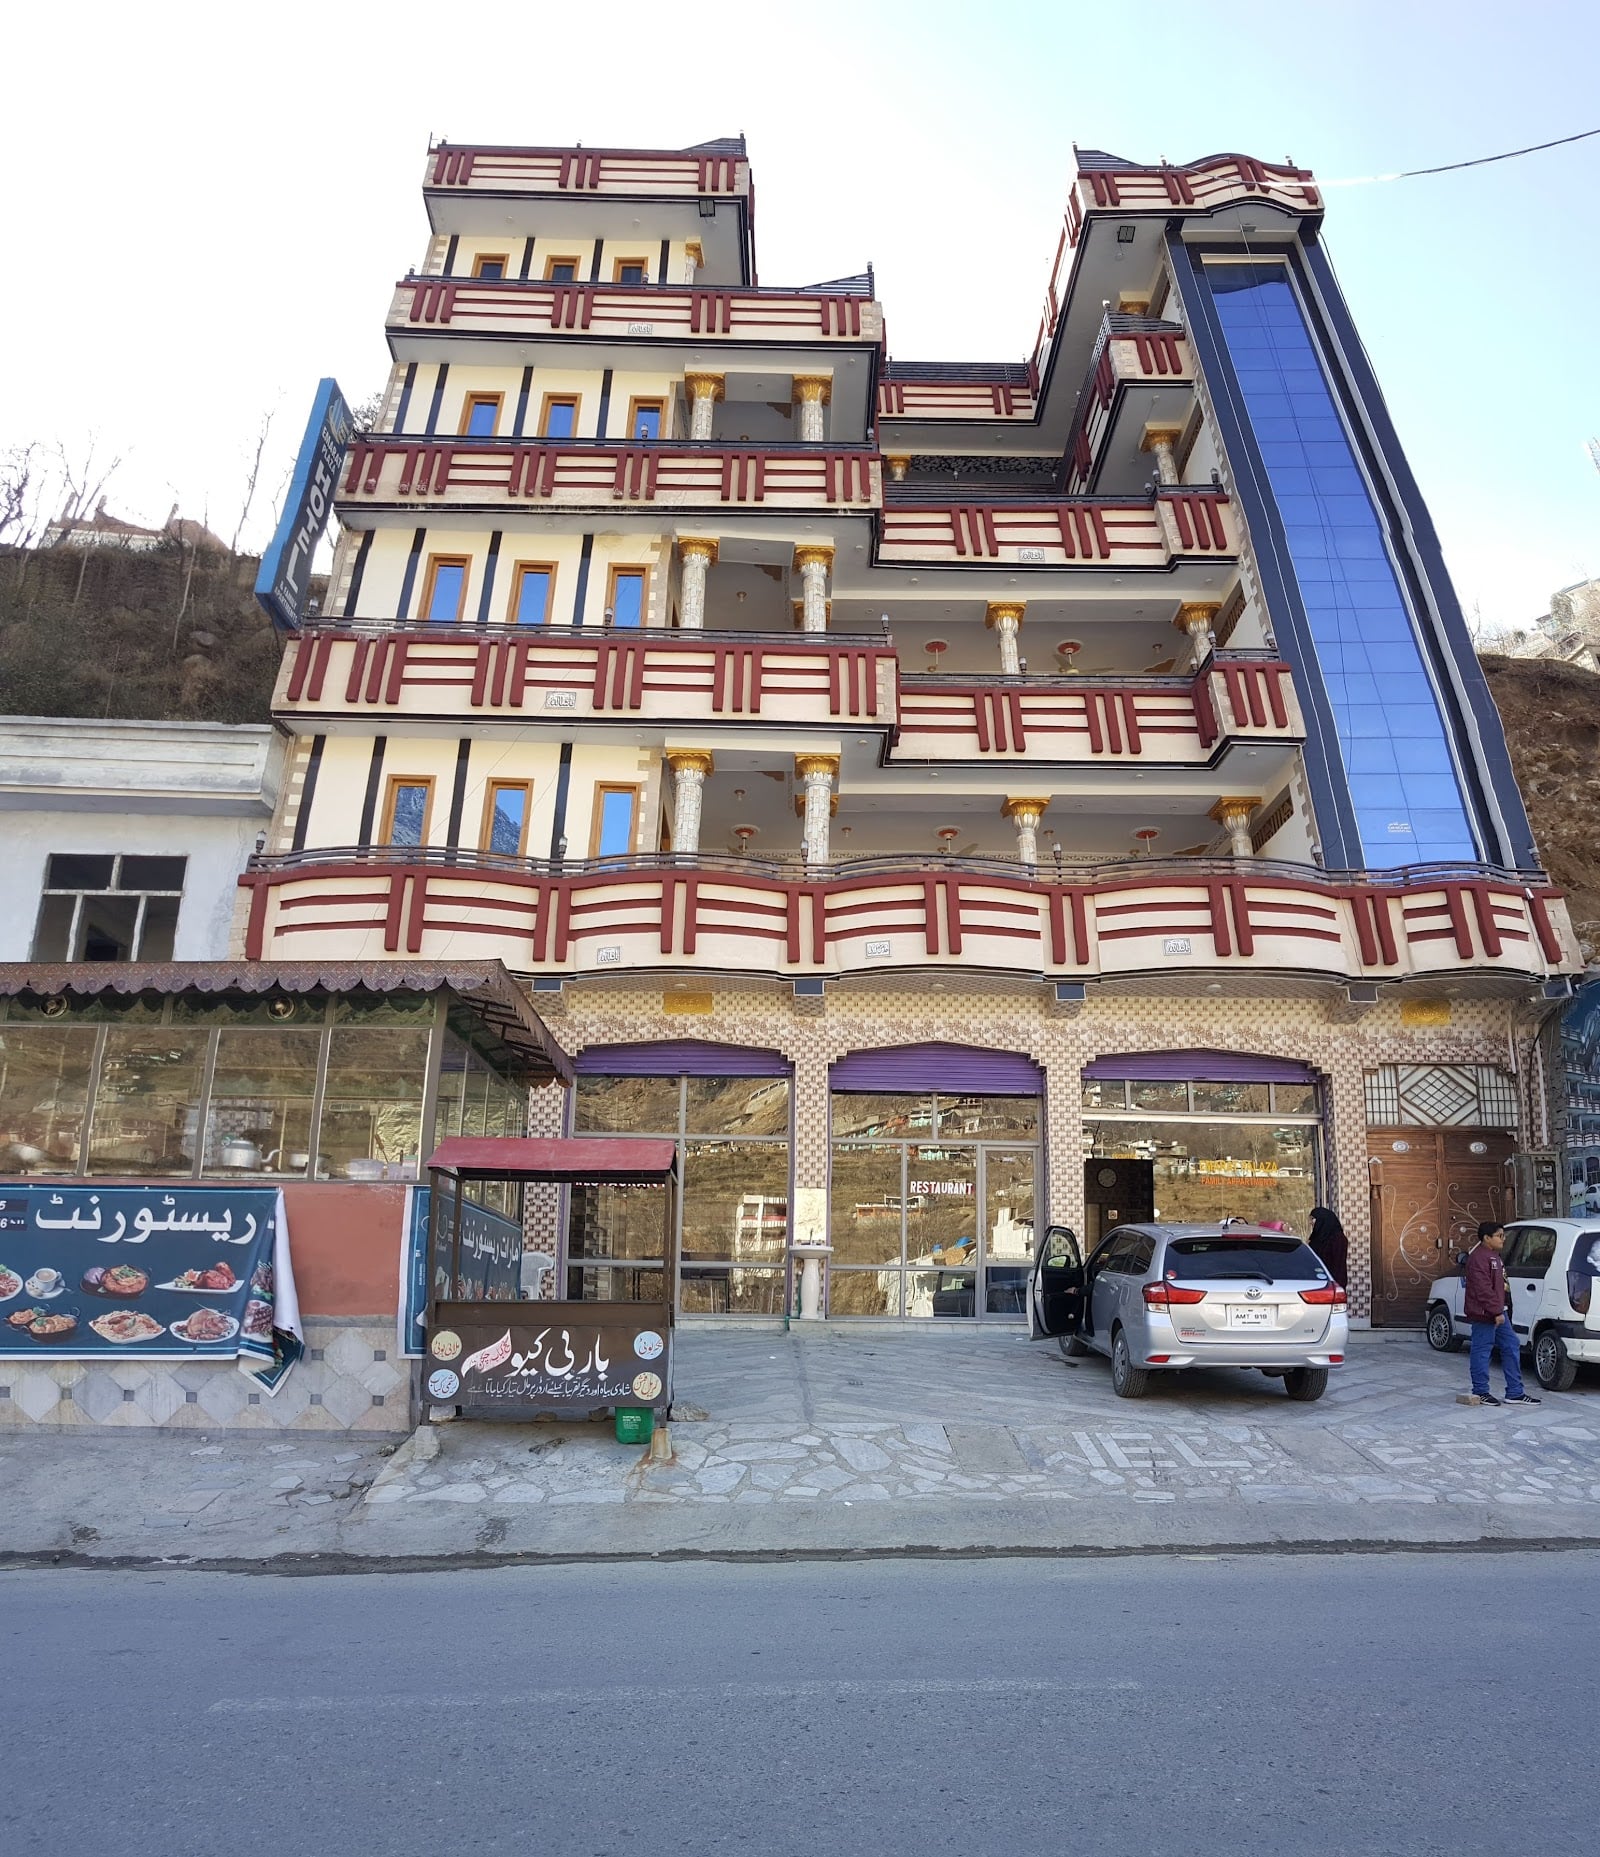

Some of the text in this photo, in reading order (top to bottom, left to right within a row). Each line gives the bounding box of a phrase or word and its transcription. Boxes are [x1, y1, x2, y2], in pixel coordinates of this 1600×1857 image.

[322, 426, 342, 469] EMARAT
[322, 444, 336, 475] PLAZA
[286, 460, 332, 594] HOTEL
[283, 586, 297, 611] FAMILY
[910, 1181, 974, 1195] RESTAURANT
[35, 1193, 258, 1245] ریسٹورنٹ
[504, 1327, 610, 1381] بار بی کیو
[611, 1381, 632, 1397] شادی
